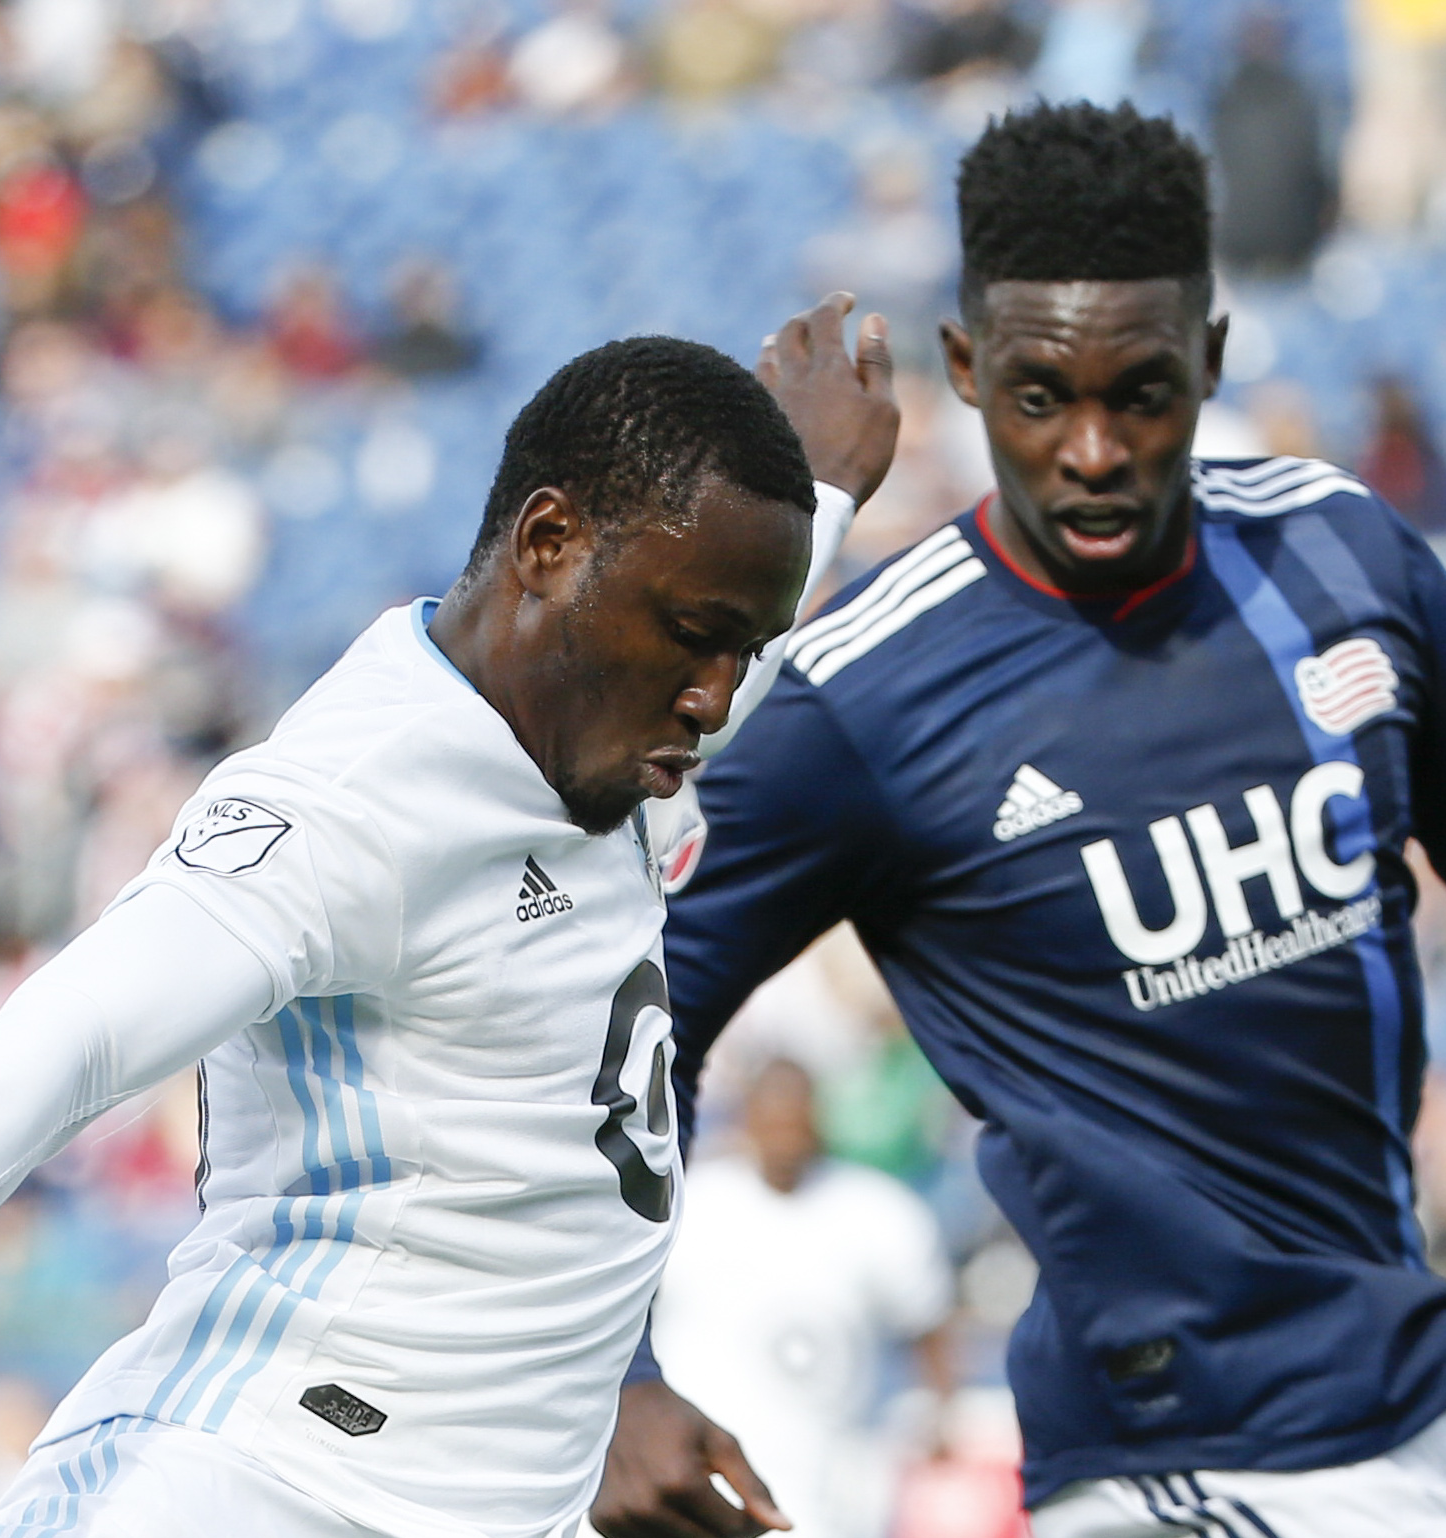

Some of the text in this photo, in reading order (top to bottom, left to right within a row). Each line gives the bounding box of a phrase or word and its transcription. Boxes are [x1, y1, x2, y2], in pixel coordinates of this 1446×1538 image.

[212, 803, 252, 821] MLS
[993, 790, 1084, 842] adidas
[1080, 760, 1377, 965] UHC
[516, 893, 574, 923] adidas
